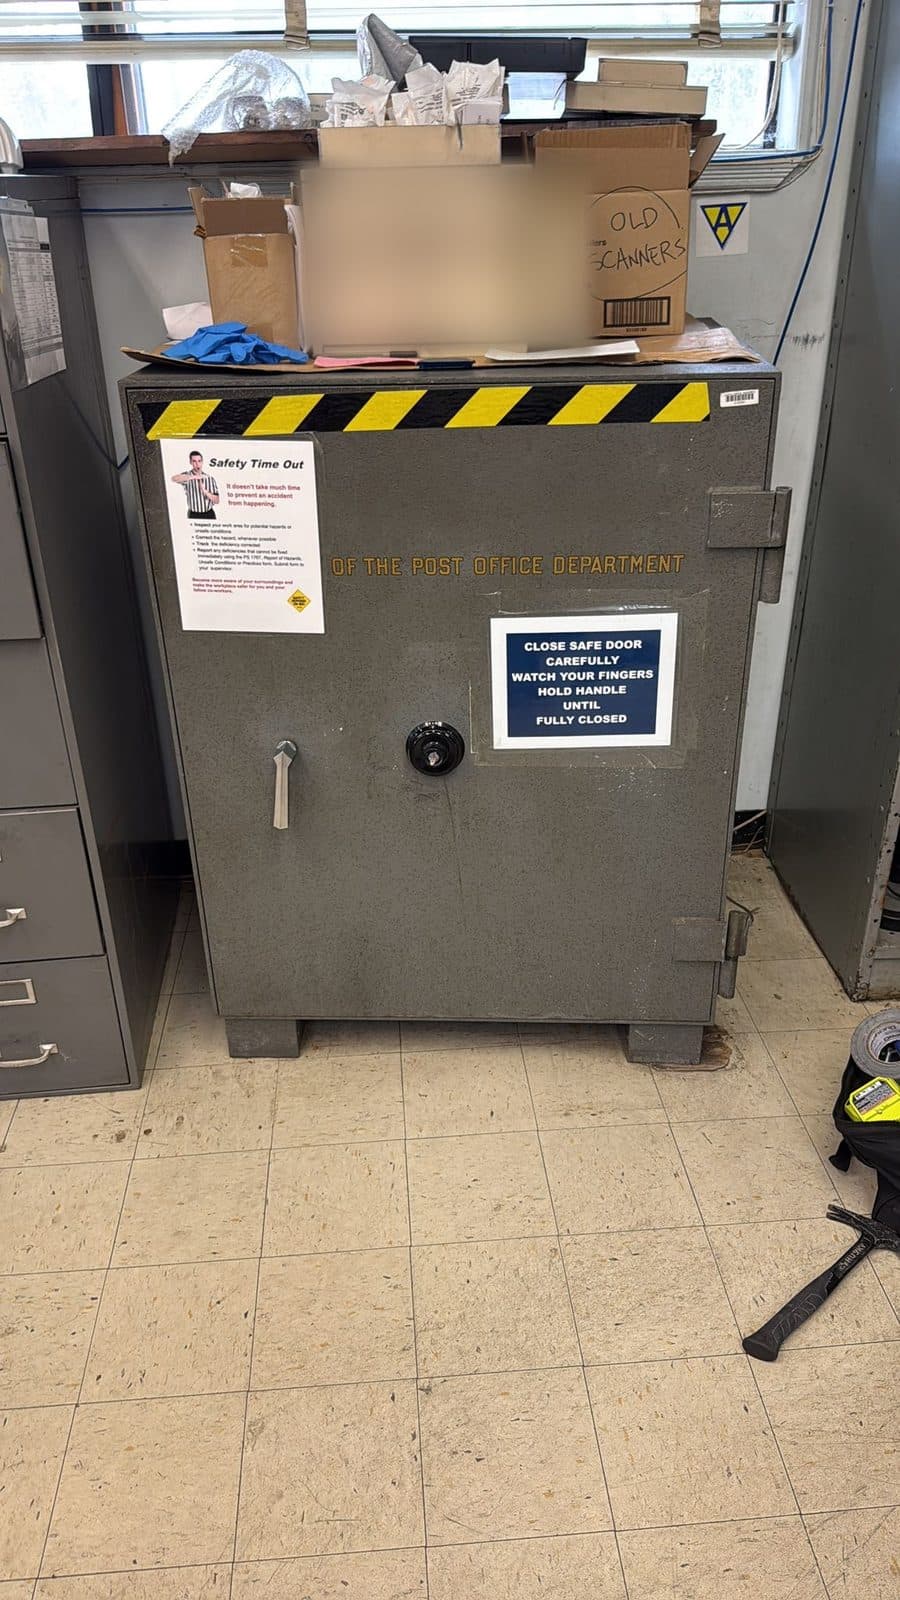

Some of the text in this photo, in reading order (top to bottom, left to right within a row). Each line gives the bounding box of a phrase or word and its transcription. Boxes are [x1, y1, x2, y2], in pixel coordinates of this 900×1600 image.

[610, 207, 658, 231] OLD
[209, 458, 304, 470] Safety Time Out
[331, 554, 685, 577] OF THE POST OFFICE DEPARTMENT
[524, 640, 642, 651] CLOSE SAFE DOOR
[546, 656, 619, 666] CAREFULLY
[512, 670, 654, 682] WATCH YOUR FINGERS
[538, 685, 626, 696] HOLD HANDLE
[563, 701, 600, 711] UNTIL
[536, 714, 626, 726] FULLY CLOSED
